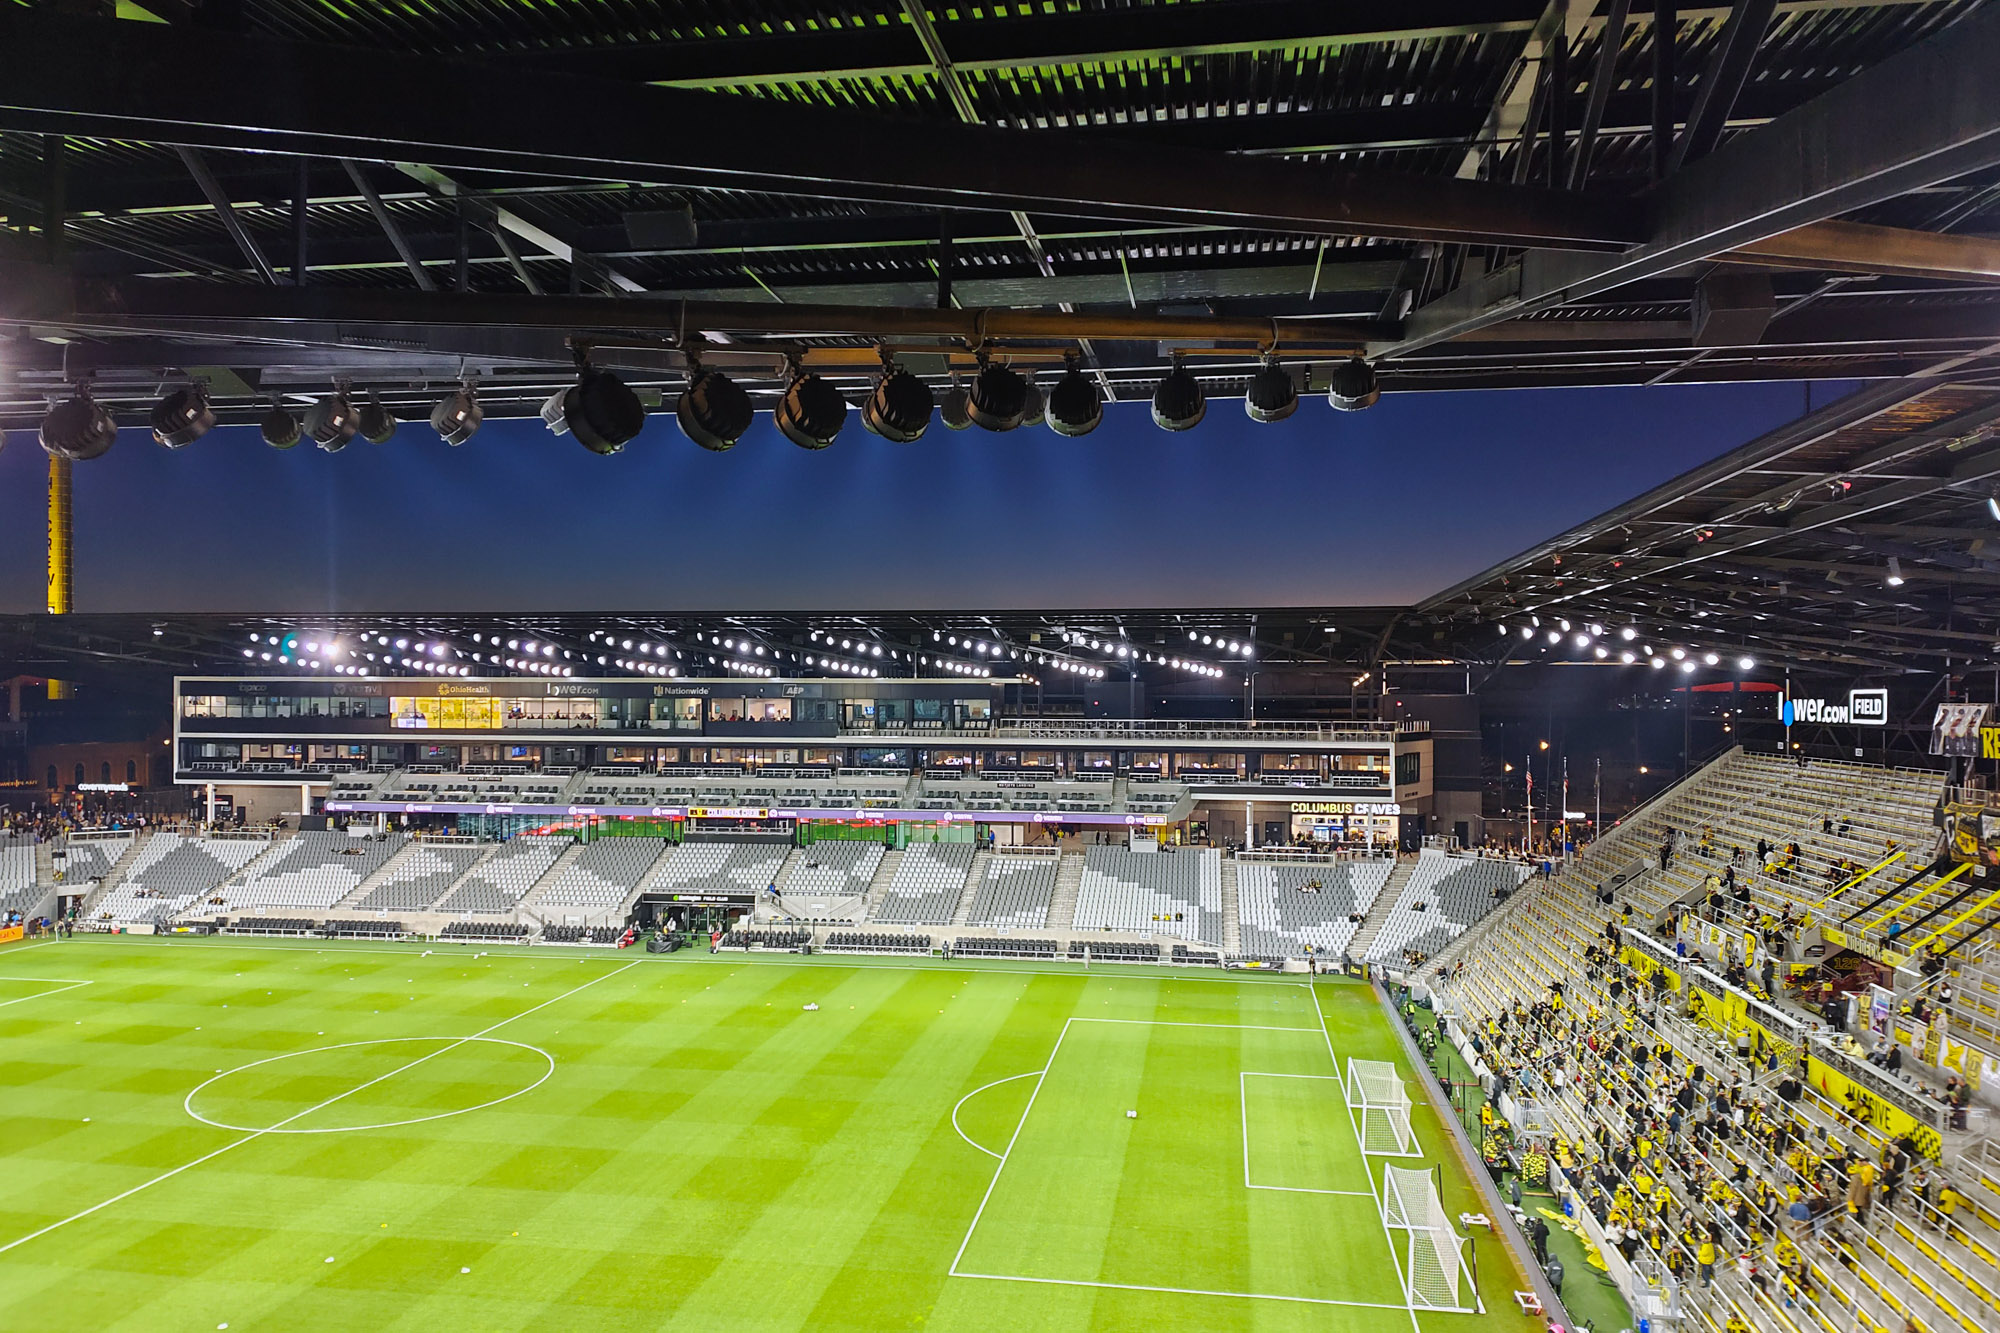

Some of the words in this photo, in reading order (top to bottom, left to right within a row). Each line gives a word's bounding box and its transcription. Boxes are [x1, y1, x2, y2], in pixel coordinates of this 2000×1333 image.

[450, 685, 490, 694] OhioHealth
[664, 685, 709, 695] Nationwide
[786, 686, 804, 695] AEP
[1854, 697, 1882, 716] FIELD
[78, 782, 129, 793] covermymeds
[1290, 802, 1353, 814] COLUMBUS
[1354, 803, 1401, 815] CRAVES
[1834, 956, 1862, 970] 126
